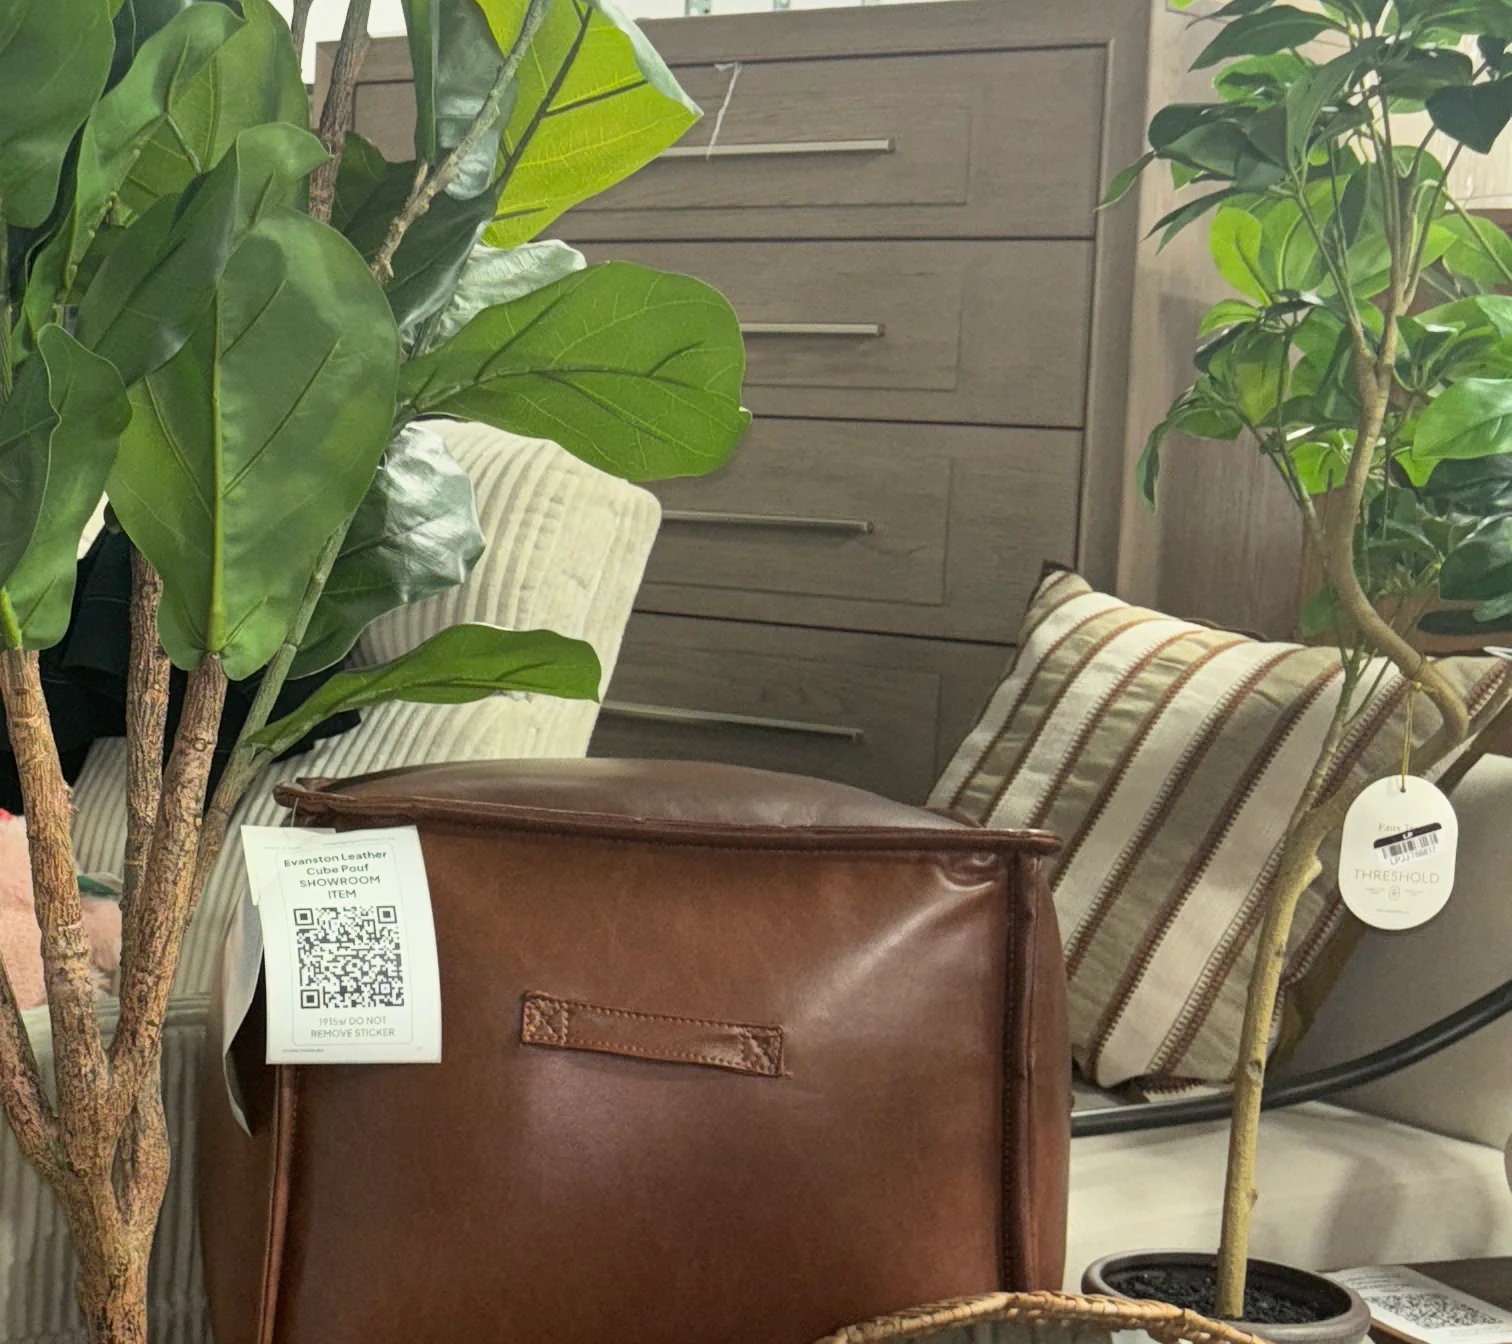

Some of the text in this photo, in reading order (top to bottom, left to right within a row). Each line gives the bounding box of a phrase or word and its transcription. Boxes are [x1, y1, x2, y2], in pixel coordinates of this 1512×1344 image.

[284, 851, 387, 867] Evanston Leather
[306, 863, 369, 875] Cube Pouf
[300, 876, 381, 887] SHOWROOM
[1354, 869, 1440, 884] THRESHOLD
[328, 890, 356, 899] ITEM
[349, 1017, 364, 1025] DO
[366, 1016, 386, 1024] NOT
[311, 1028, 395, 1038] REMOVE STICKER
